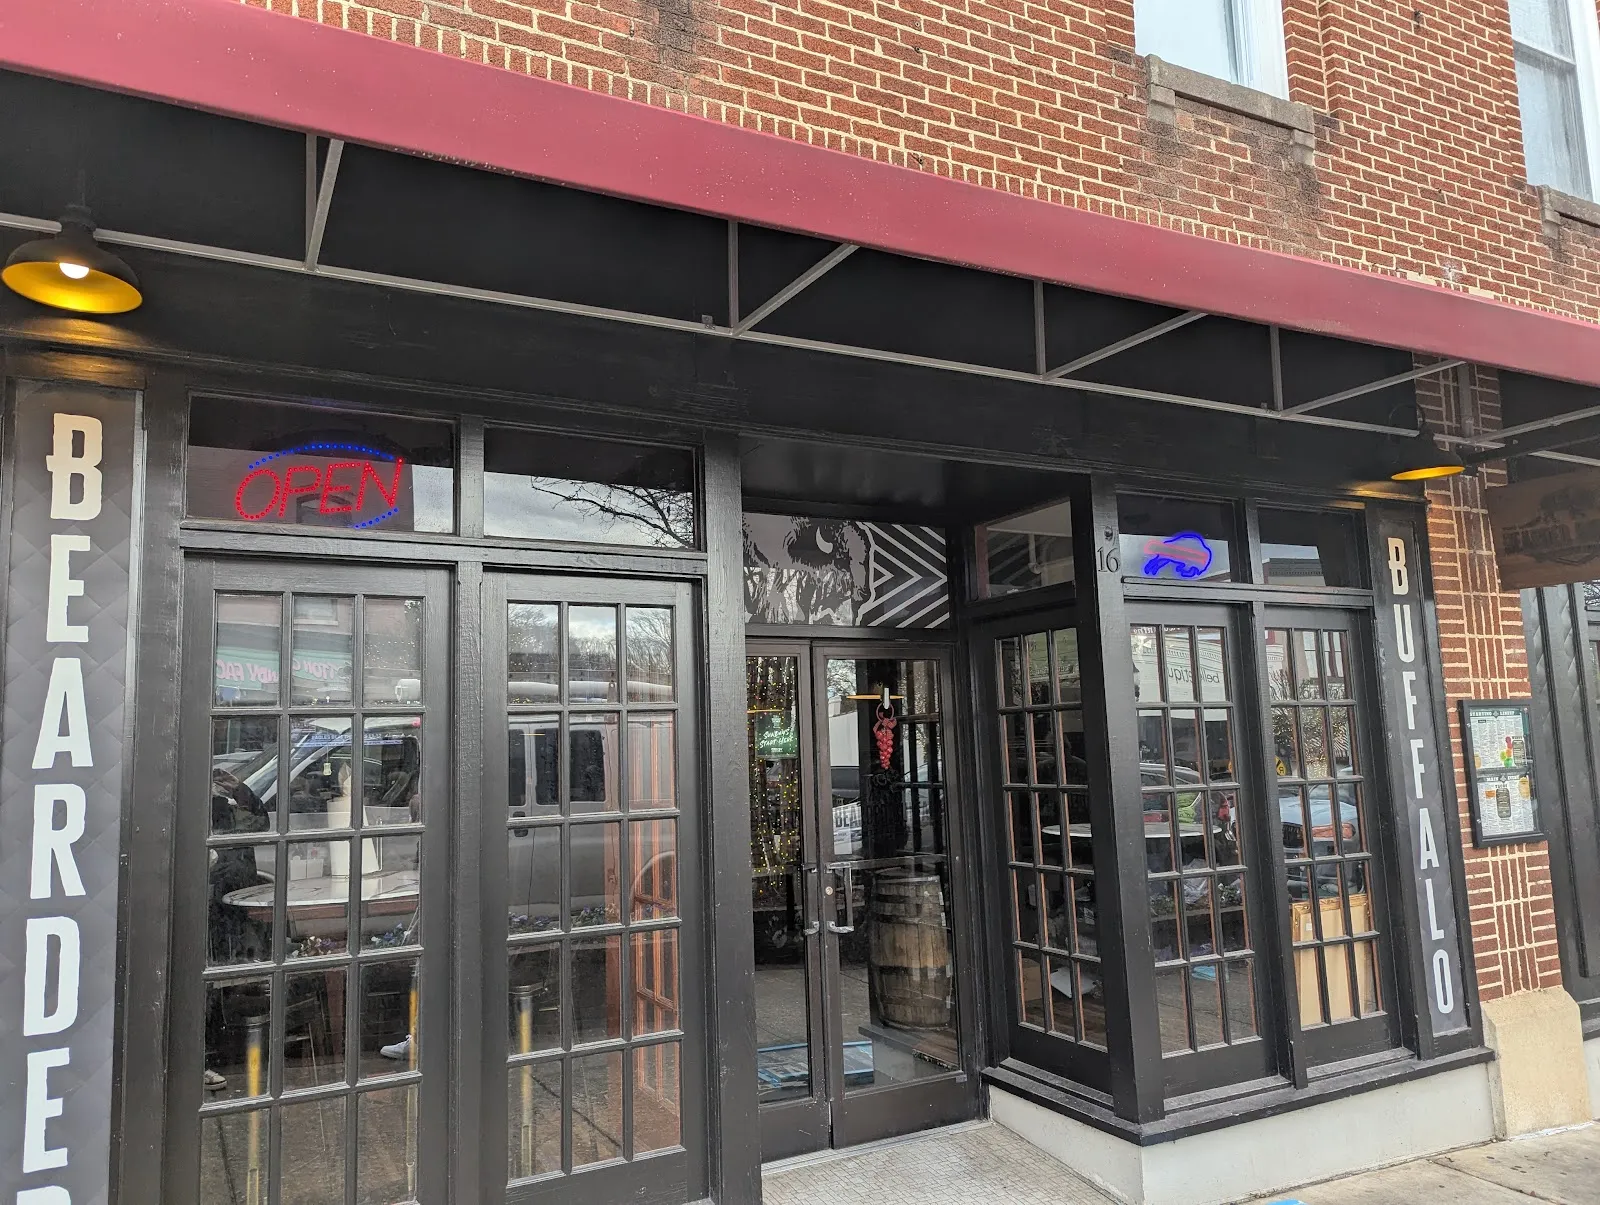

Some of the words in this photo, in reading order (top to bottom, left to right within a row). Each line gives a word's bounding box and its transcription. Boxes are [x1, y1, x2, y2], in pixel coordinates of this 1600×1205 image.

[235, 457, 403, 521] OPEN
[1096, 546, 1119, 573] 16
[16, 412, 103, 1205] BEARDE
[1387, 537, 1455, 1014] BUFFALO
